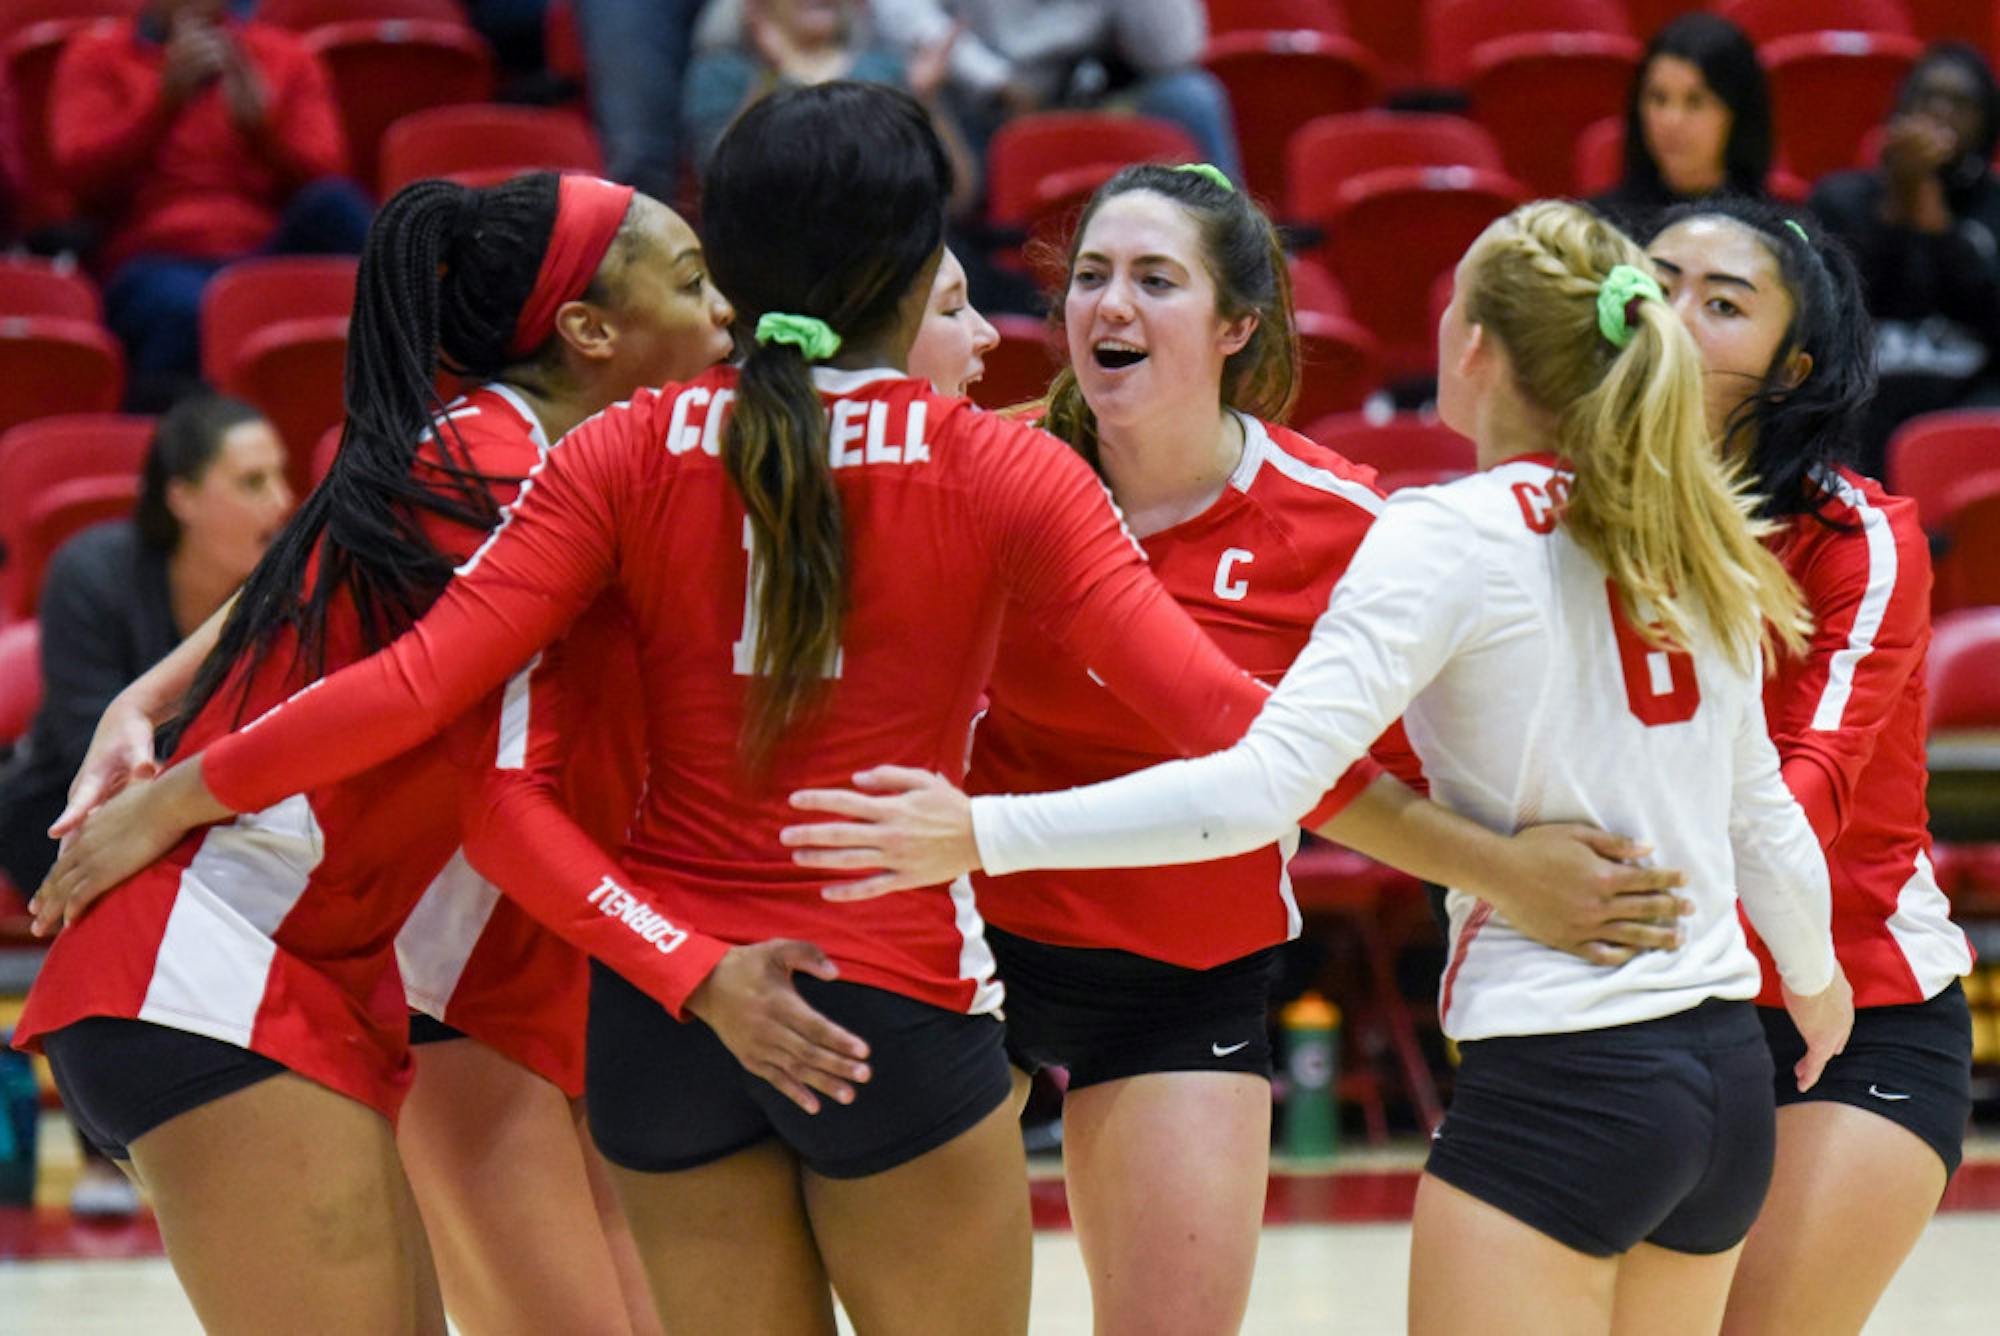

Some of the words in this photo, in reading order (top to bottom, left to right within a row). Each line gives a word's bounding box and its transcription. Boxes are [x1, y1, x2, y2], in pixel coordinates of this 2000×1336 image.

[666, 386, 930, 469] COELL
[1213, 547, 1254, 601] C
[587, 875, 688, 954] CORNELL
